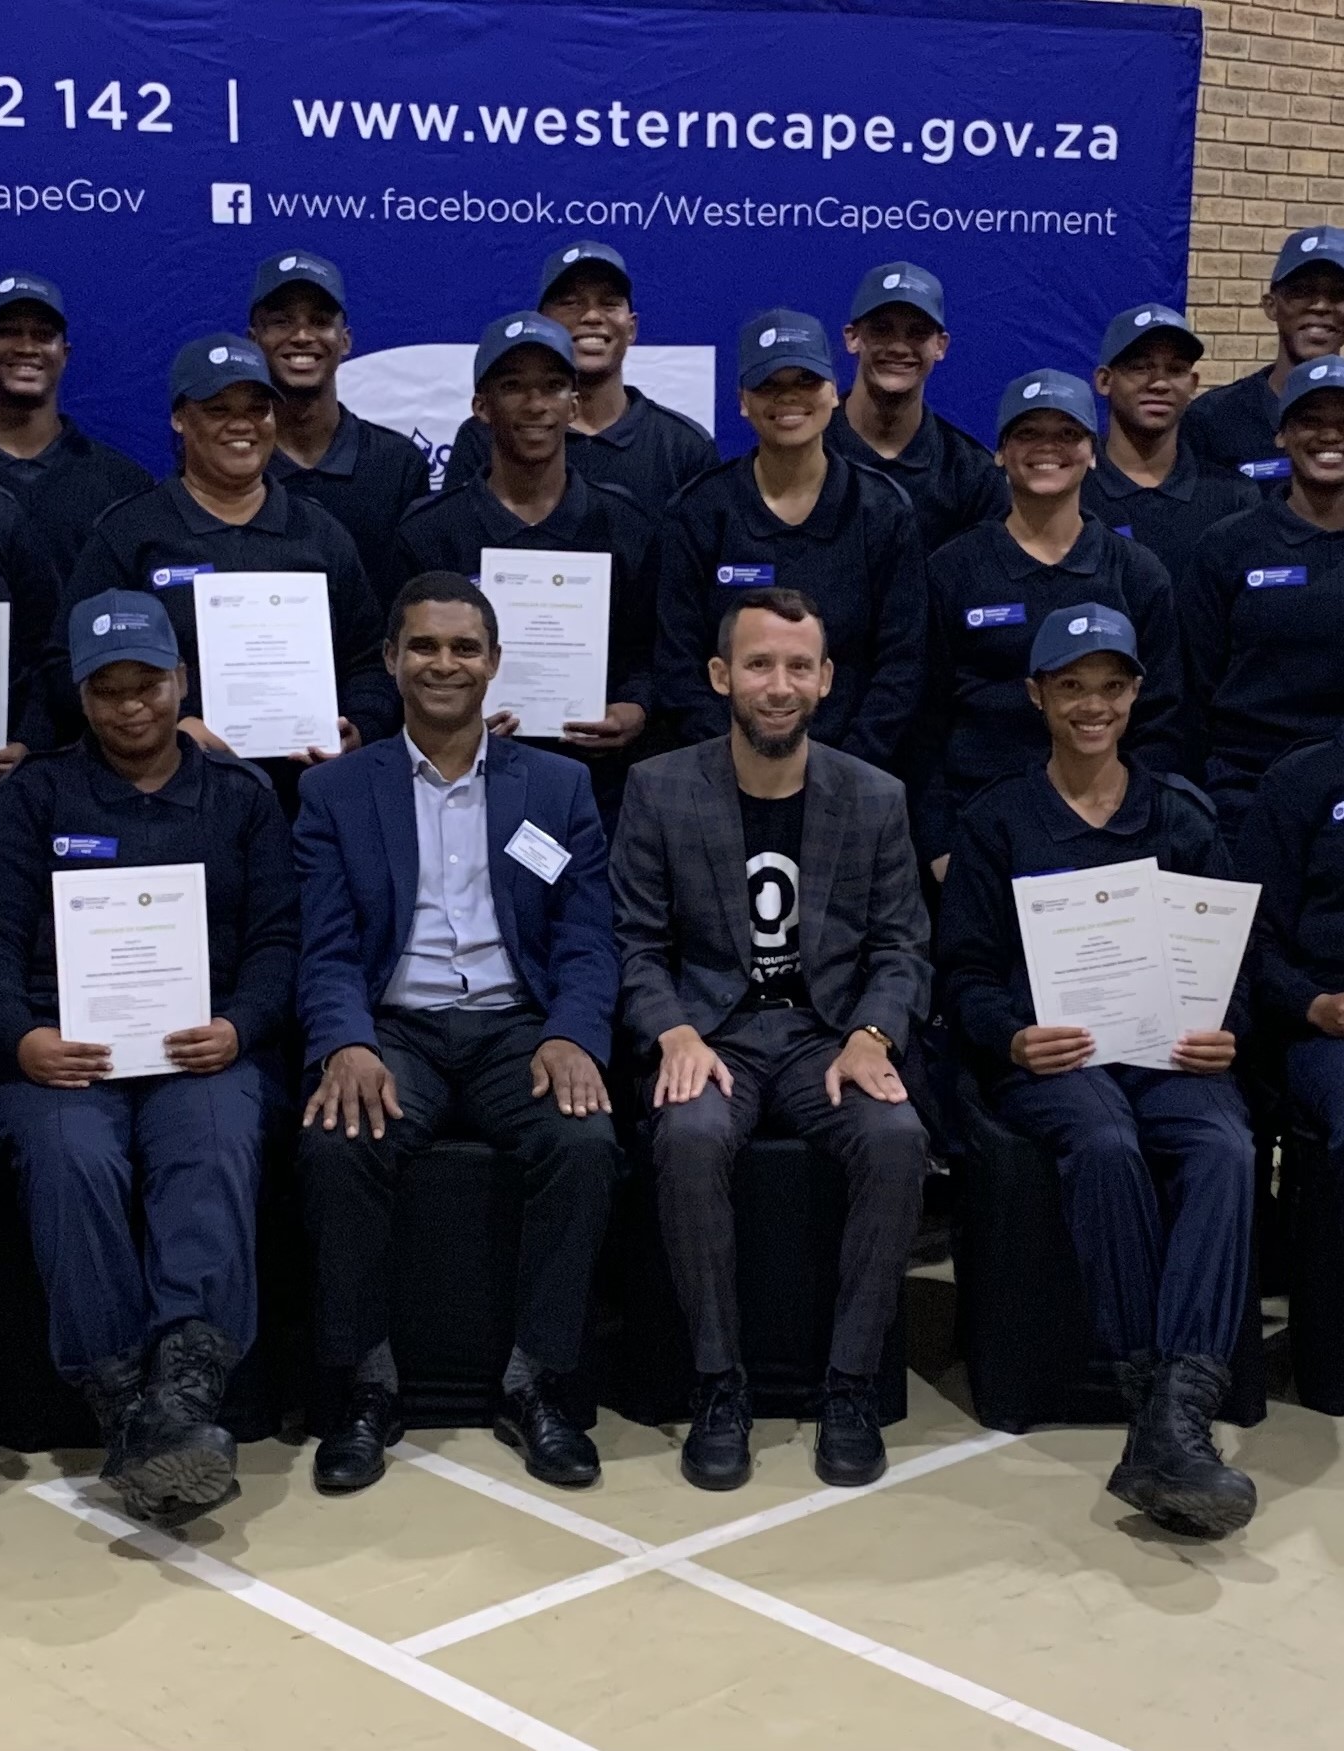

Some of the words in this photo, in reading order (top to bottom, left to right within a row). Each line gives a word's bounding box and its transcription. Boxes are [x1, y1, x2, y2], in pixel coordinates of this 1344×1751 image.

[54, 78, 173, 133] 142
[292, 99, 1119, 164] www.westerncape.gov.za
[267, 187, 1117, 237] www.facebook.com/WesternCapeGovernment
